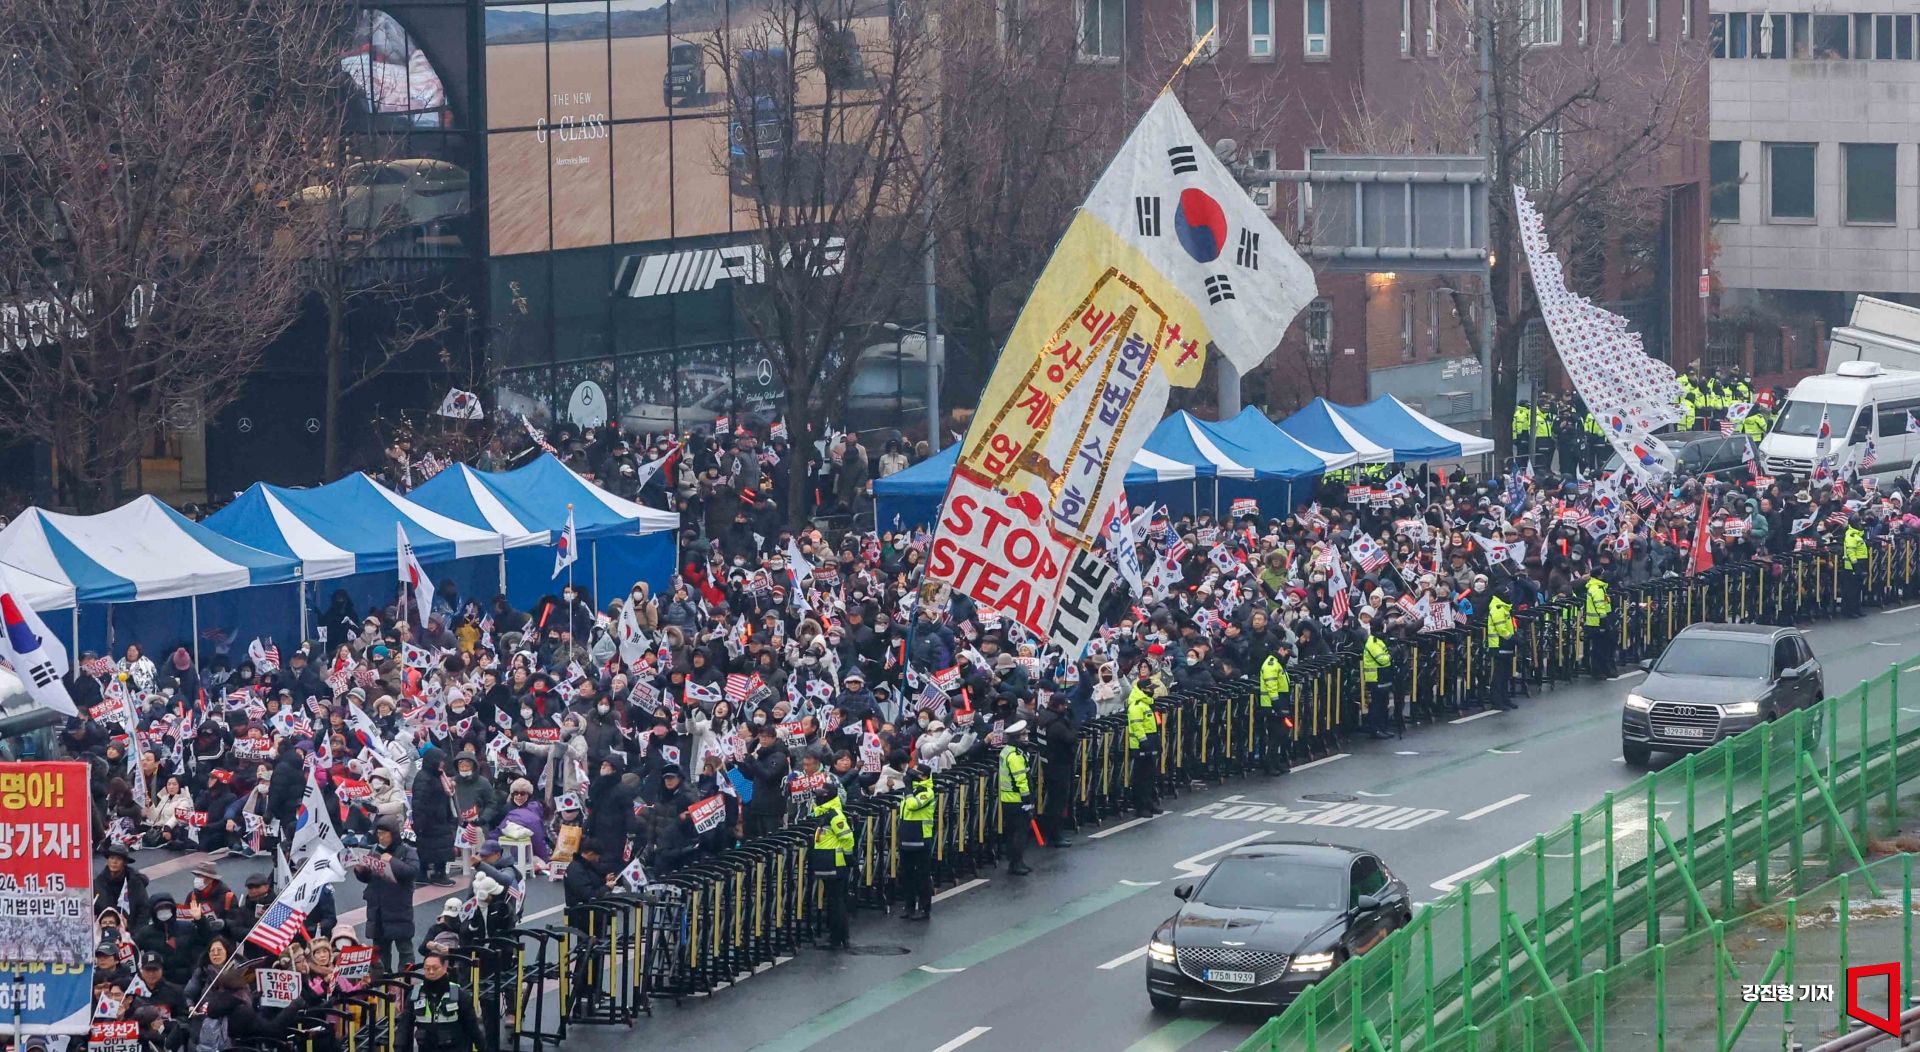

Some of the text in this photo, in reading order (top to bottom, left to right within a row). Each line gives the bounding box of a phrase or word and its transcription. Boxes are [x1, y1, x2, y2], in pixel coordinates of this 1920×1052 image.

[553, 92, 592, 106] THE NEW
[943, 495, 1058, 582] STOP
[929, 537, 1046, 640] STEAL
[1050, 548, 1110, 646] THE
[792, 773, 825, 788] 부정선거
[0, 771, 64, 810] 명아!
[0, 899, 79, 917] 거법위반 1심
[341, 948, 373, 964] 탄핵반대
[267, 972, 293, 982] STOP
[1233, 972, 1254, 983] 1939
[270, 981, 289, 991] THE
[91, 1022, 140, 1038] 부정선거
